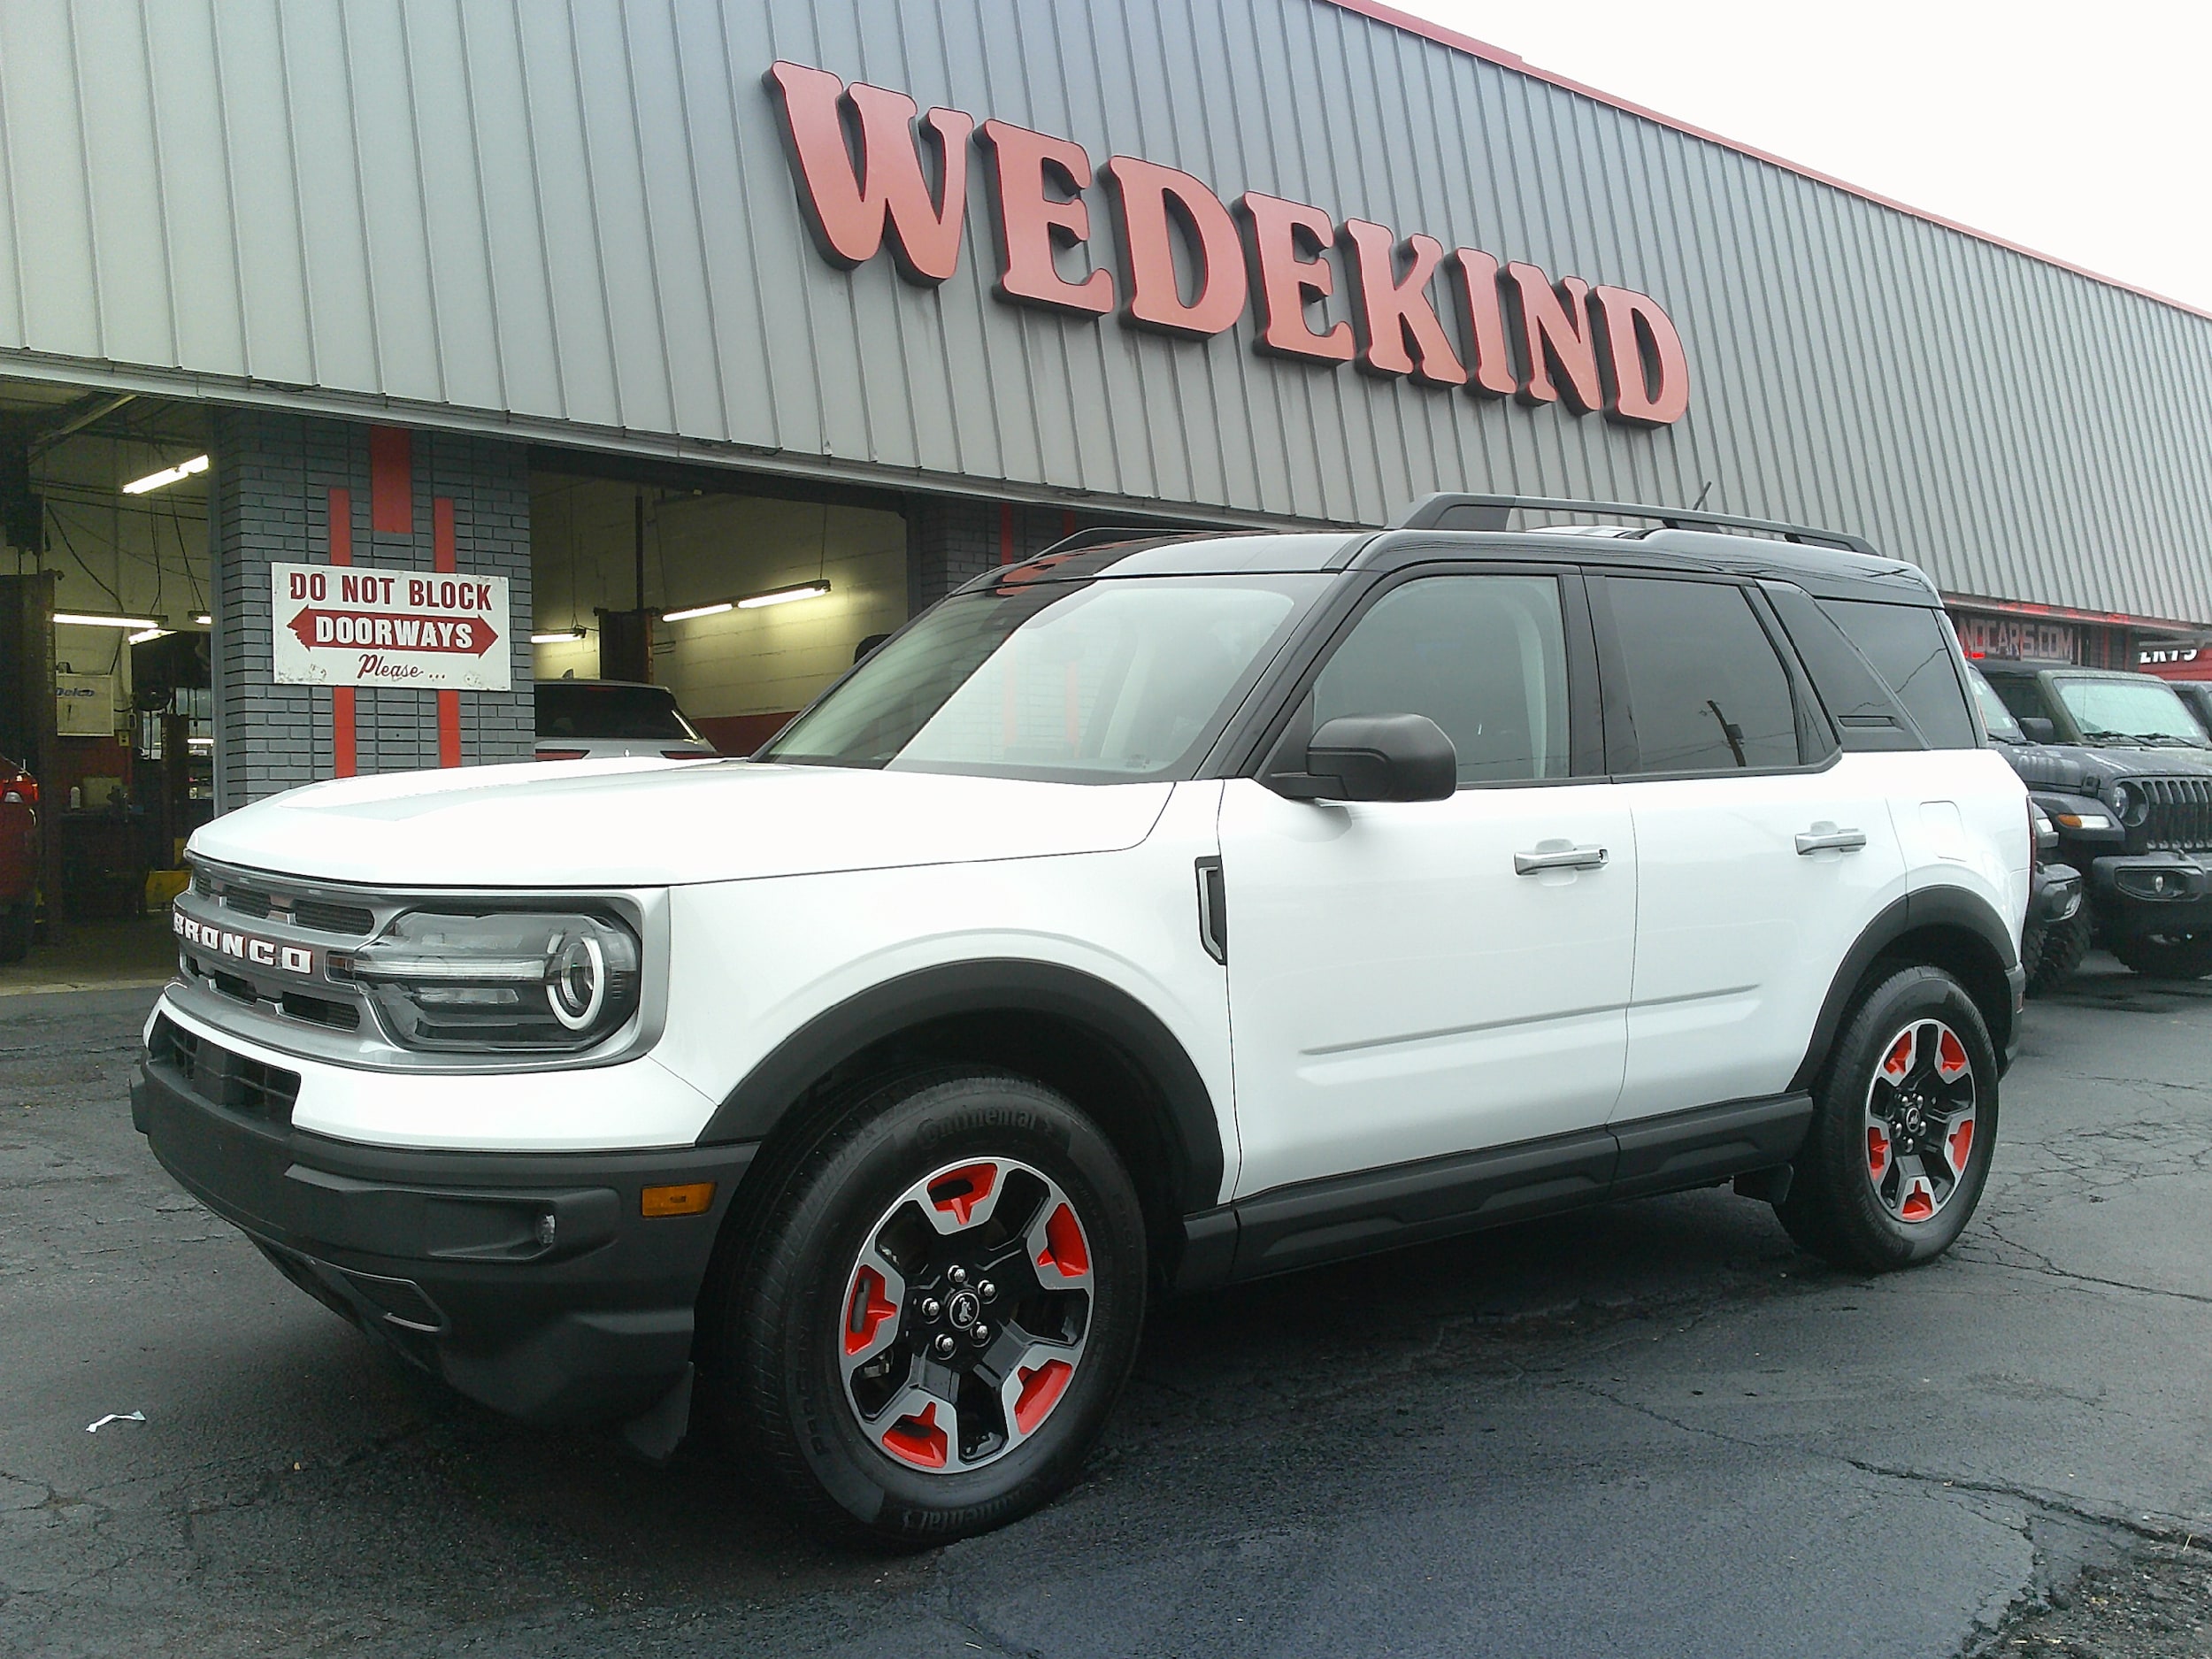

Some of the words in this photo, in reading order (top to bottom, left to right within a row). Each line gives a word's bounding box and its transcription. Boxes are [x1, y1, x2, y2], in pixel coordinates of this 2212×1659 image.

[764, 59, 1690, 429] WEDEKIND
[289, 572, 326, 603] DO
[342, 574, 395, 605] NOT
[409, 580, 492, 611] BLOCK
[315, 615, 473, 649] DOORWAYS
[173, 911, 313, 974] BRONCO
